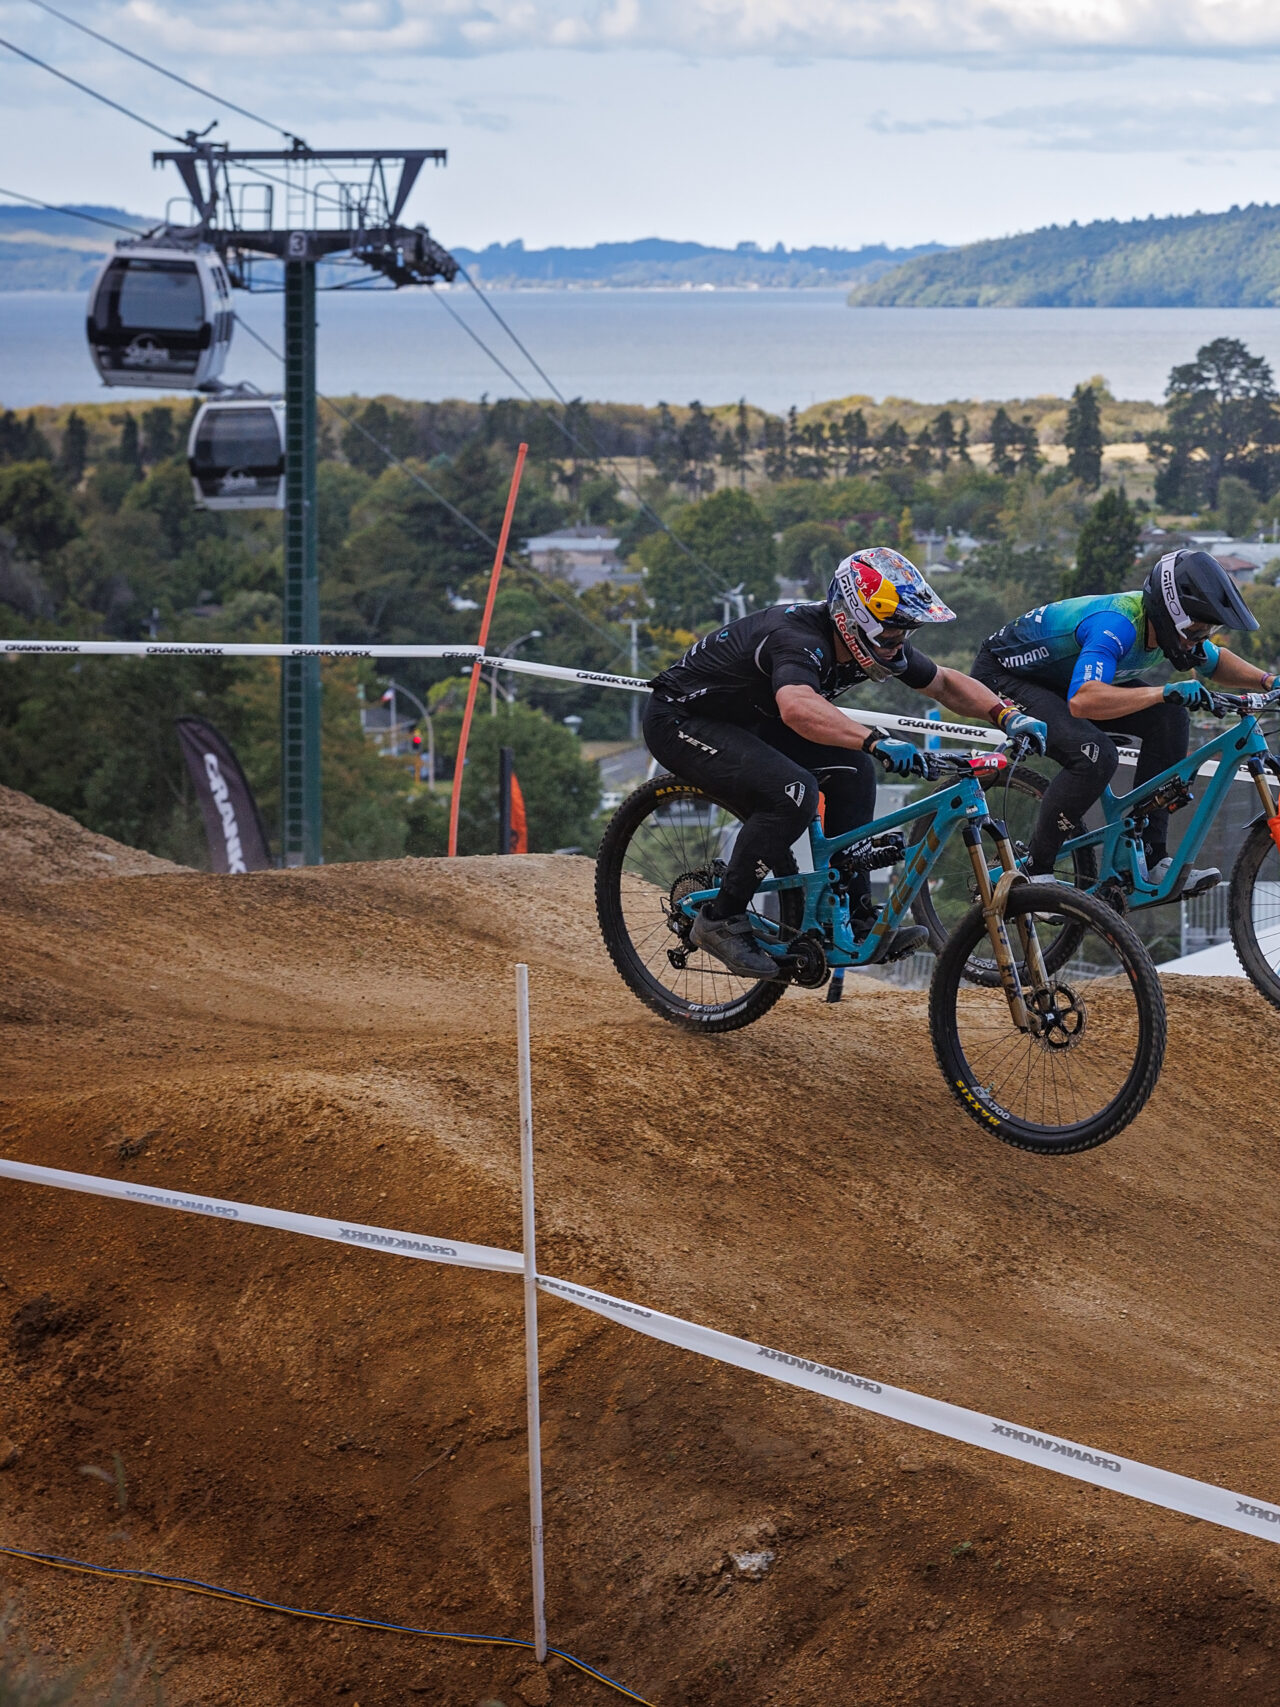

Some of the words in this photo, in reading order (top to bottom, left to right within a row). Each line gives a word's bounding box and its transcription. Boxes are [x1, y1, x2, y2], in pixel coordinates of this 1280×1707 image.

[1163, 570, 1181, 616] GIRO
[5, 644, 81, 652] CRANKWORX
[146, 646, 224, 655] CRANKWORX
[898, 718, 988, 738] CRANKWORX
[678, 730, 718, 755] YETI
[688, 1003, 703, 1012] DT
[703, 1005, 725, 1014] SWISS
[956, 1080, 1001, 1126] MAXXIS
[988, 1101, 1011, 1120] 1700
